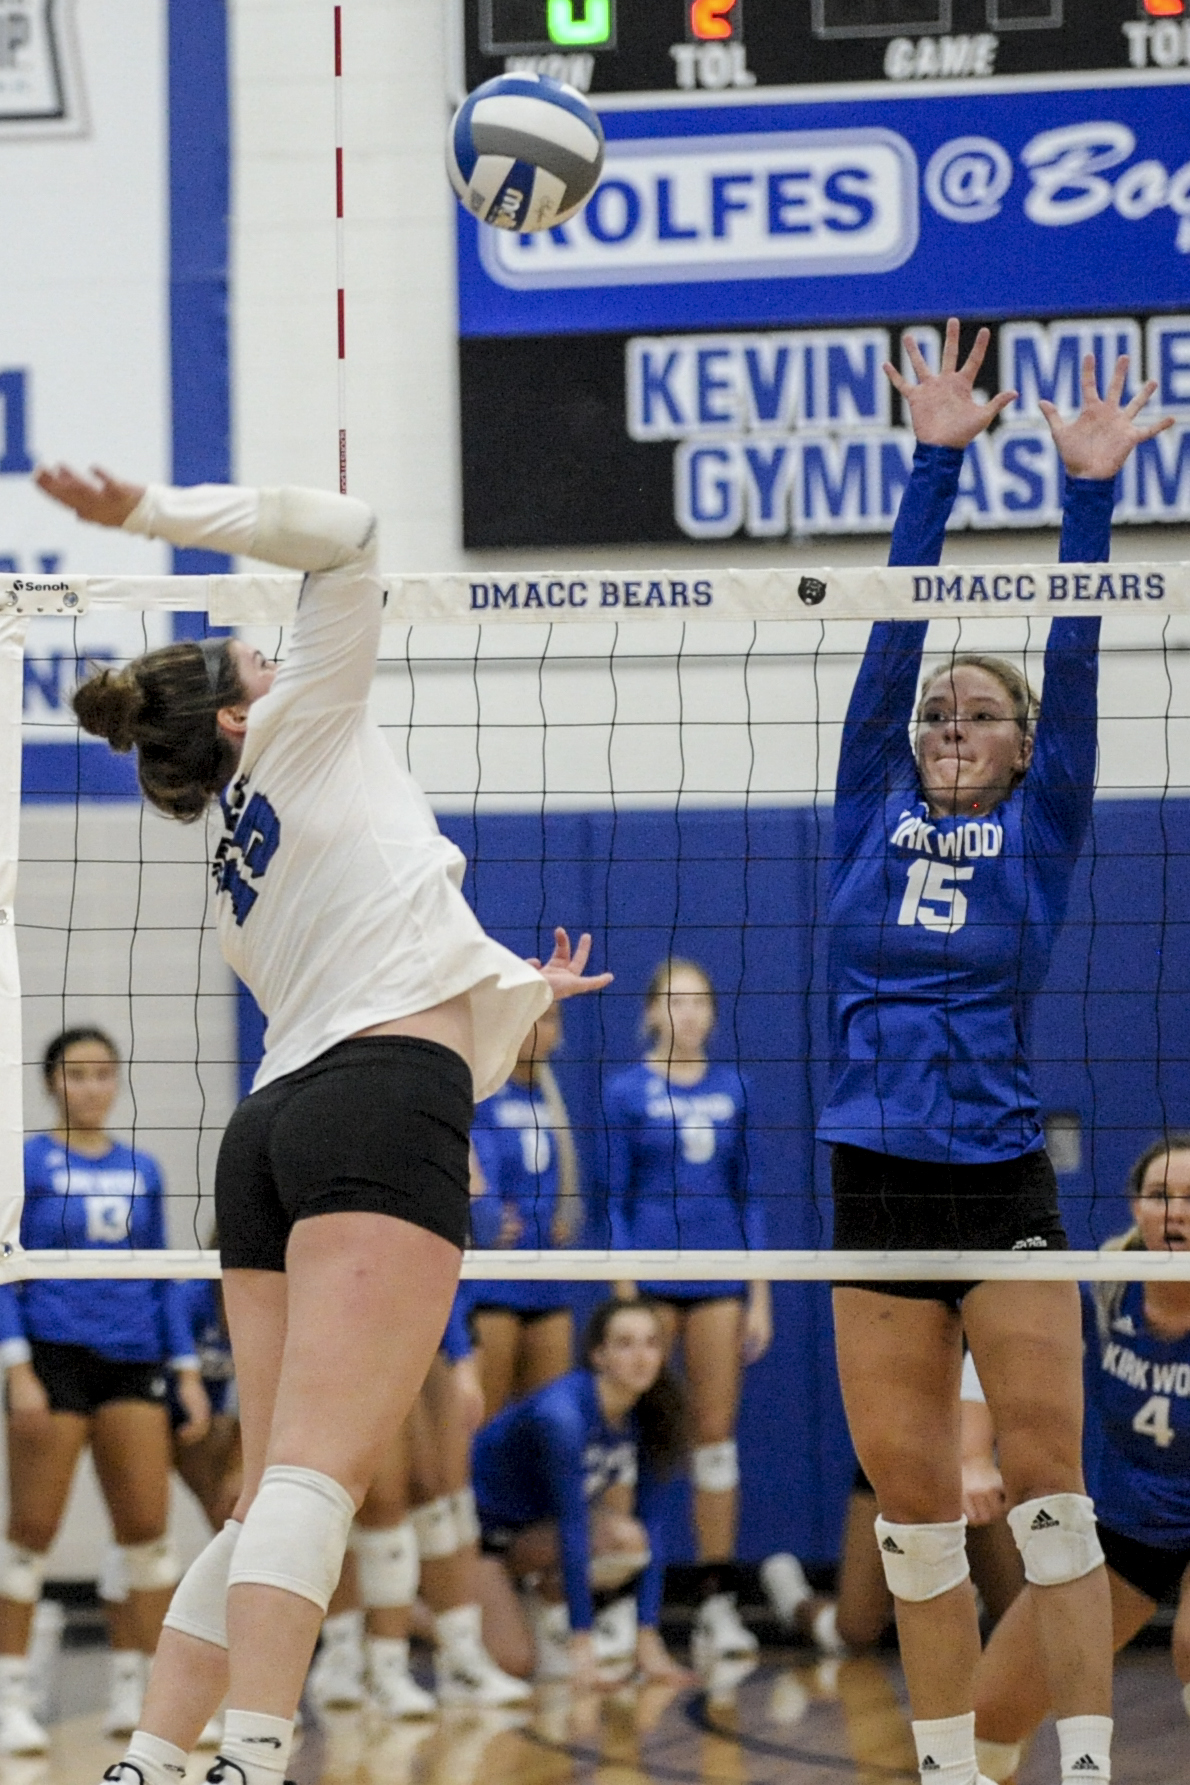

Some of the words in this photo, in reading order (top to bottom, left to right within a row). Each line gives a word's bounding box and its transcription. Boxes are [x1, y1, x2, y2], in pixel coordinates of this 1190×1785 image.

[669, 41, 757, 89] TOL
[884, 33, 998, 80] GAME
[636, 339, 884, 430] KEVIN
[25, 582, 69, 591] Senoh
[470, 581, 588, 610] DMACC
[599, 579, 714, 608] BEARS
[912, 574, 1036, 603] DMACC
[1047, 571, 1165, 602] BEARS
[897, 858, 975, 934] 15
[1132, 1395, 1176, 1448] 4
